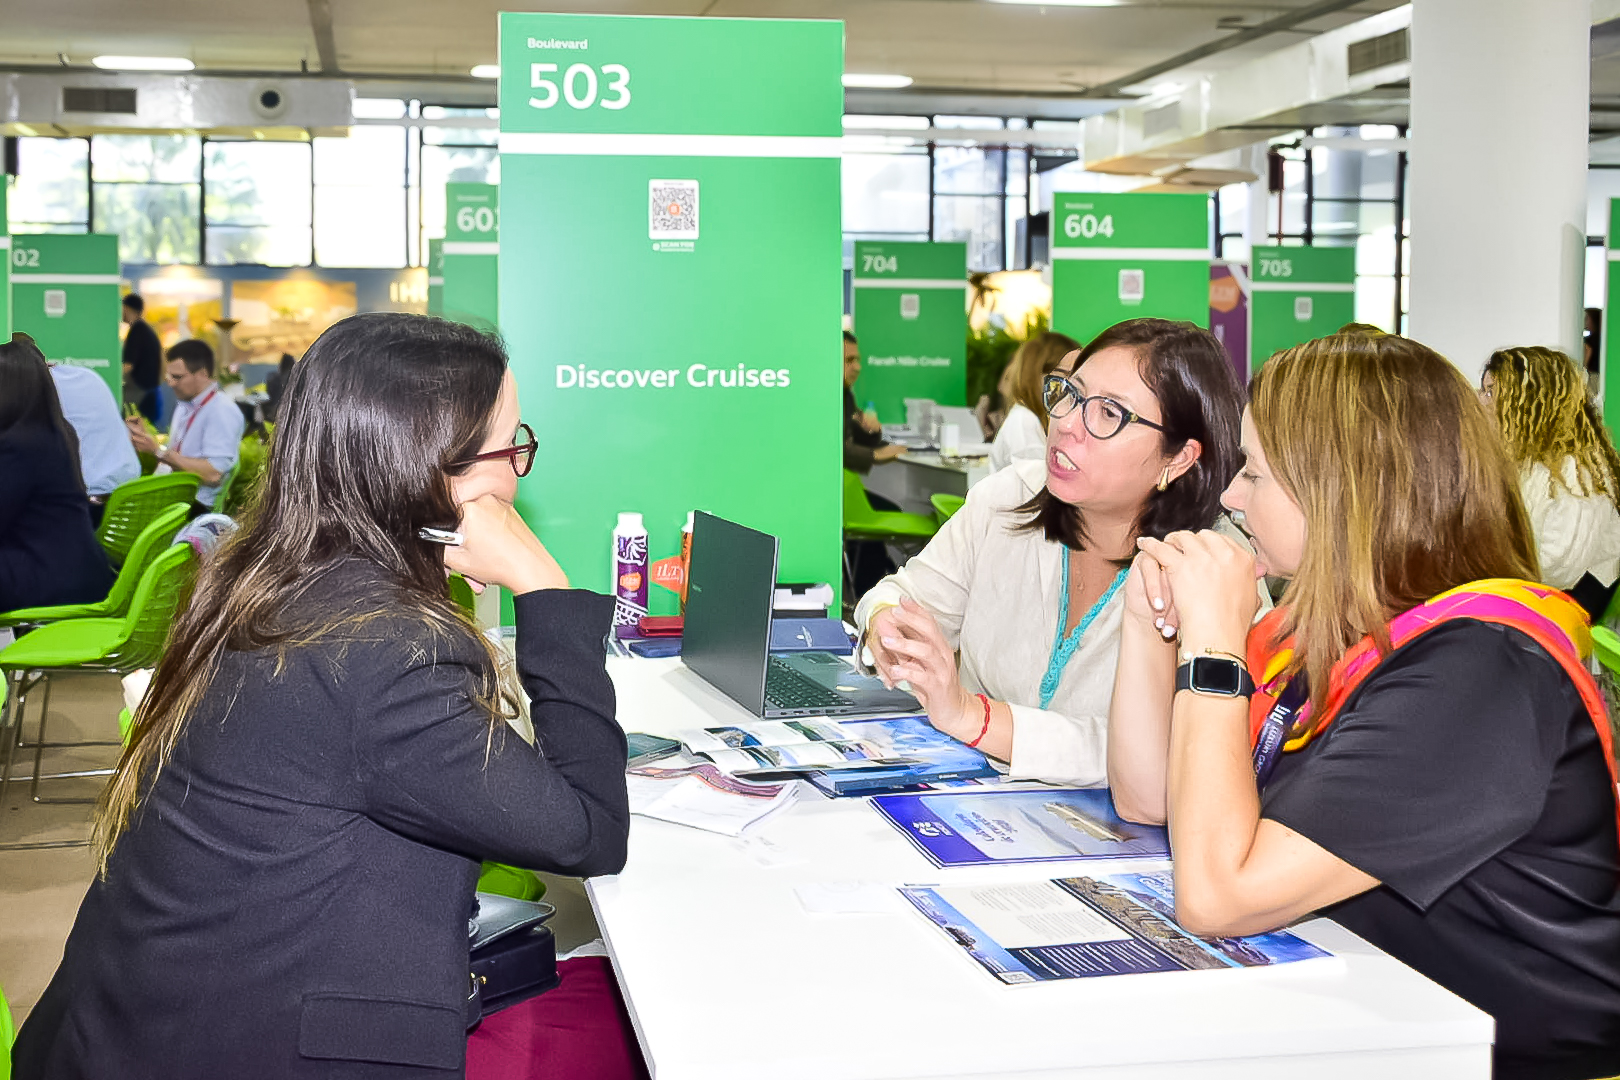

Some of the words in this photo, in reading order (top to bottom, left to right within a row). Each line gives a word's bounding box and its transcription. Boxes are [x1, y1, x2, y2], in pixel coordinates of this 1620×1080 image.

[527, 37, 588, 50] Boulevard
[528, 62, 632, 110] 503
[456, 206, 499, 233] 60
[1064, 213, 1115, 239] 604
[12, 248, 39, 267] 02
[862, 254, 898, 272] 704
[1259, 259, 1293, 277] 705
[555, 363, 680, 389] Discover
[686, 362, 791, 388] Cruises
